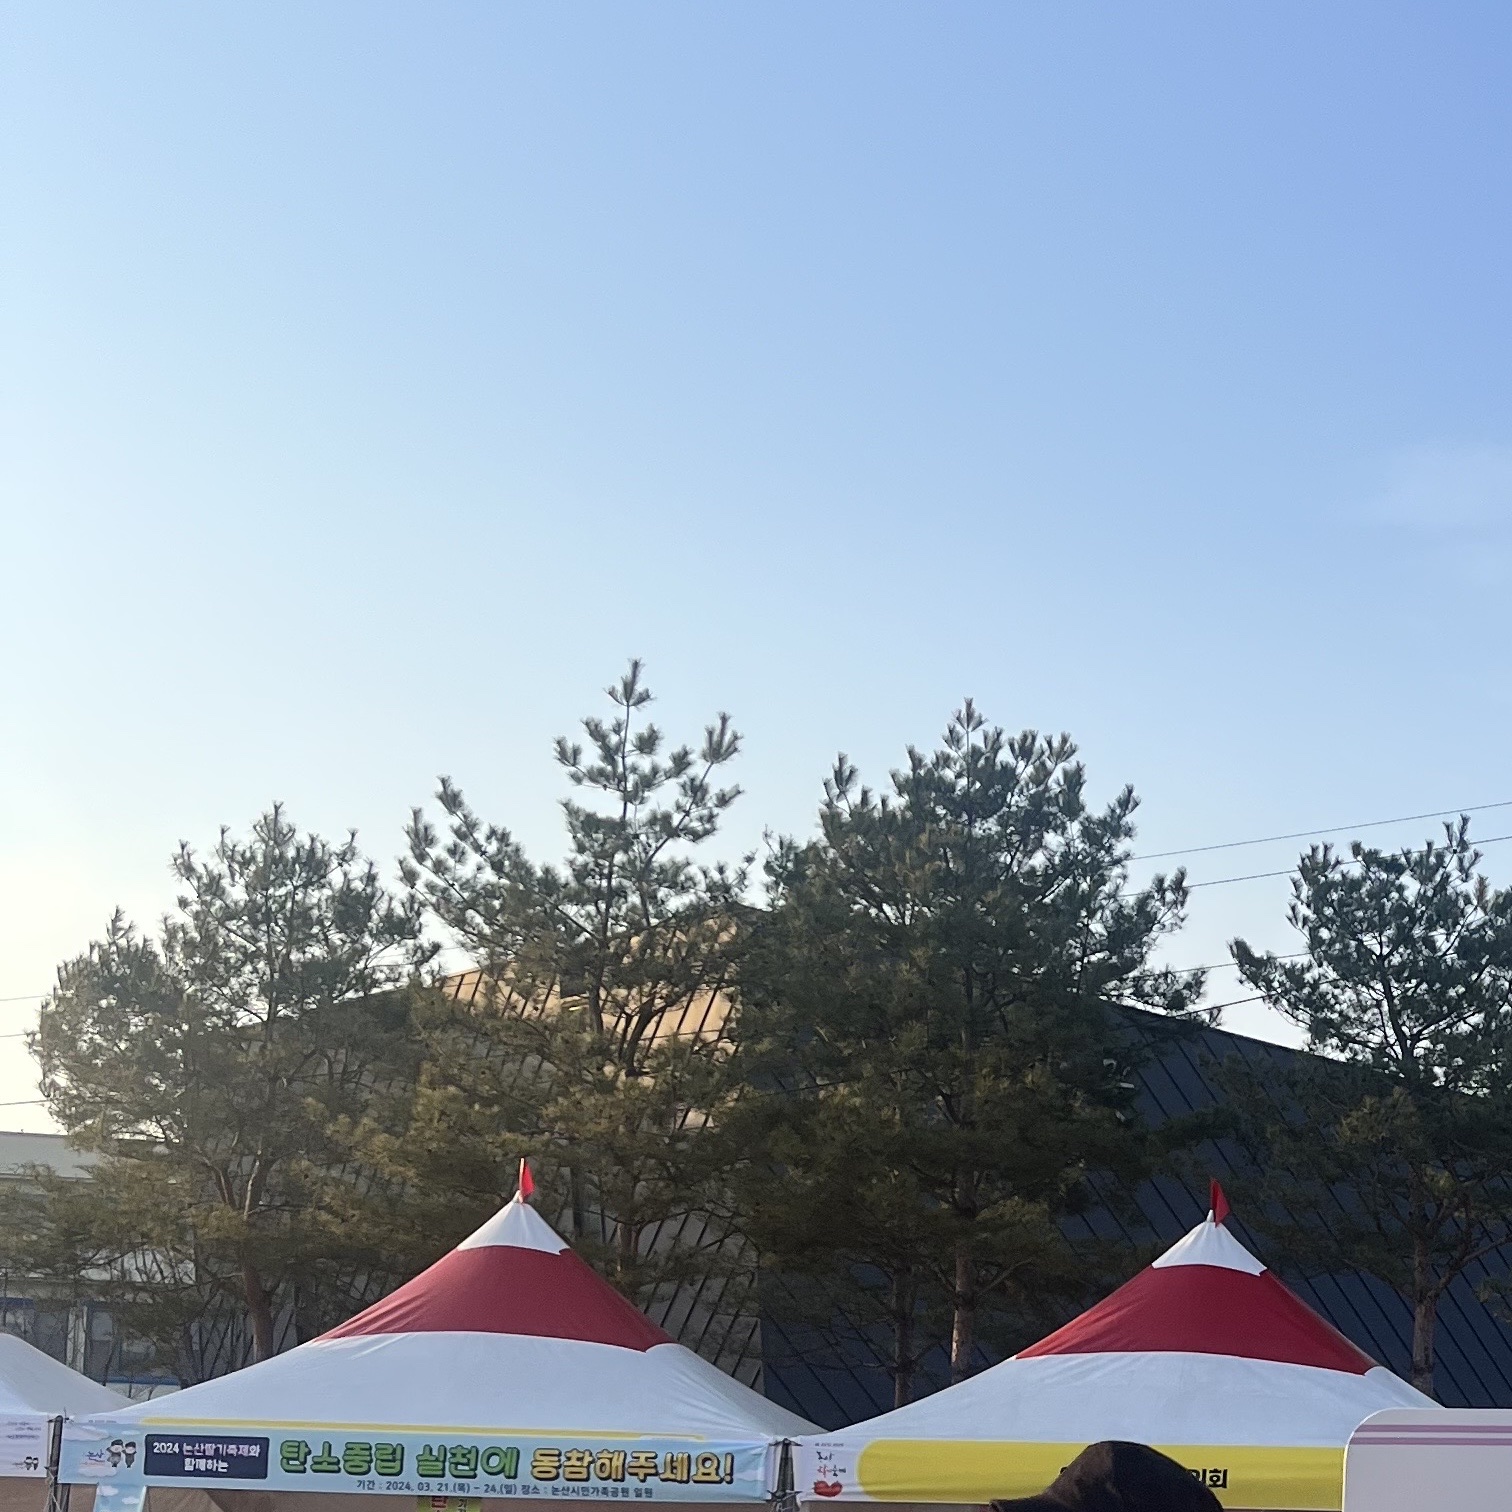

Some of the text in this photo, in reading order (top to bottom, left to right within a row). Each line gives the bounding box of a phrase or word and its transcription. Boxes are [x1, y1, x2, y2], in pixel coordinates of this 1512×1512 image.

[153, 1441, 261, 1458] 2024 논산딸기축제와
[184, 1457, 229, 1473] 함께하는
[280, 1439, 735, 1484] 탄소중립 실천에 동참해주세요!
[357, 1479, 376, 1491] 기간
